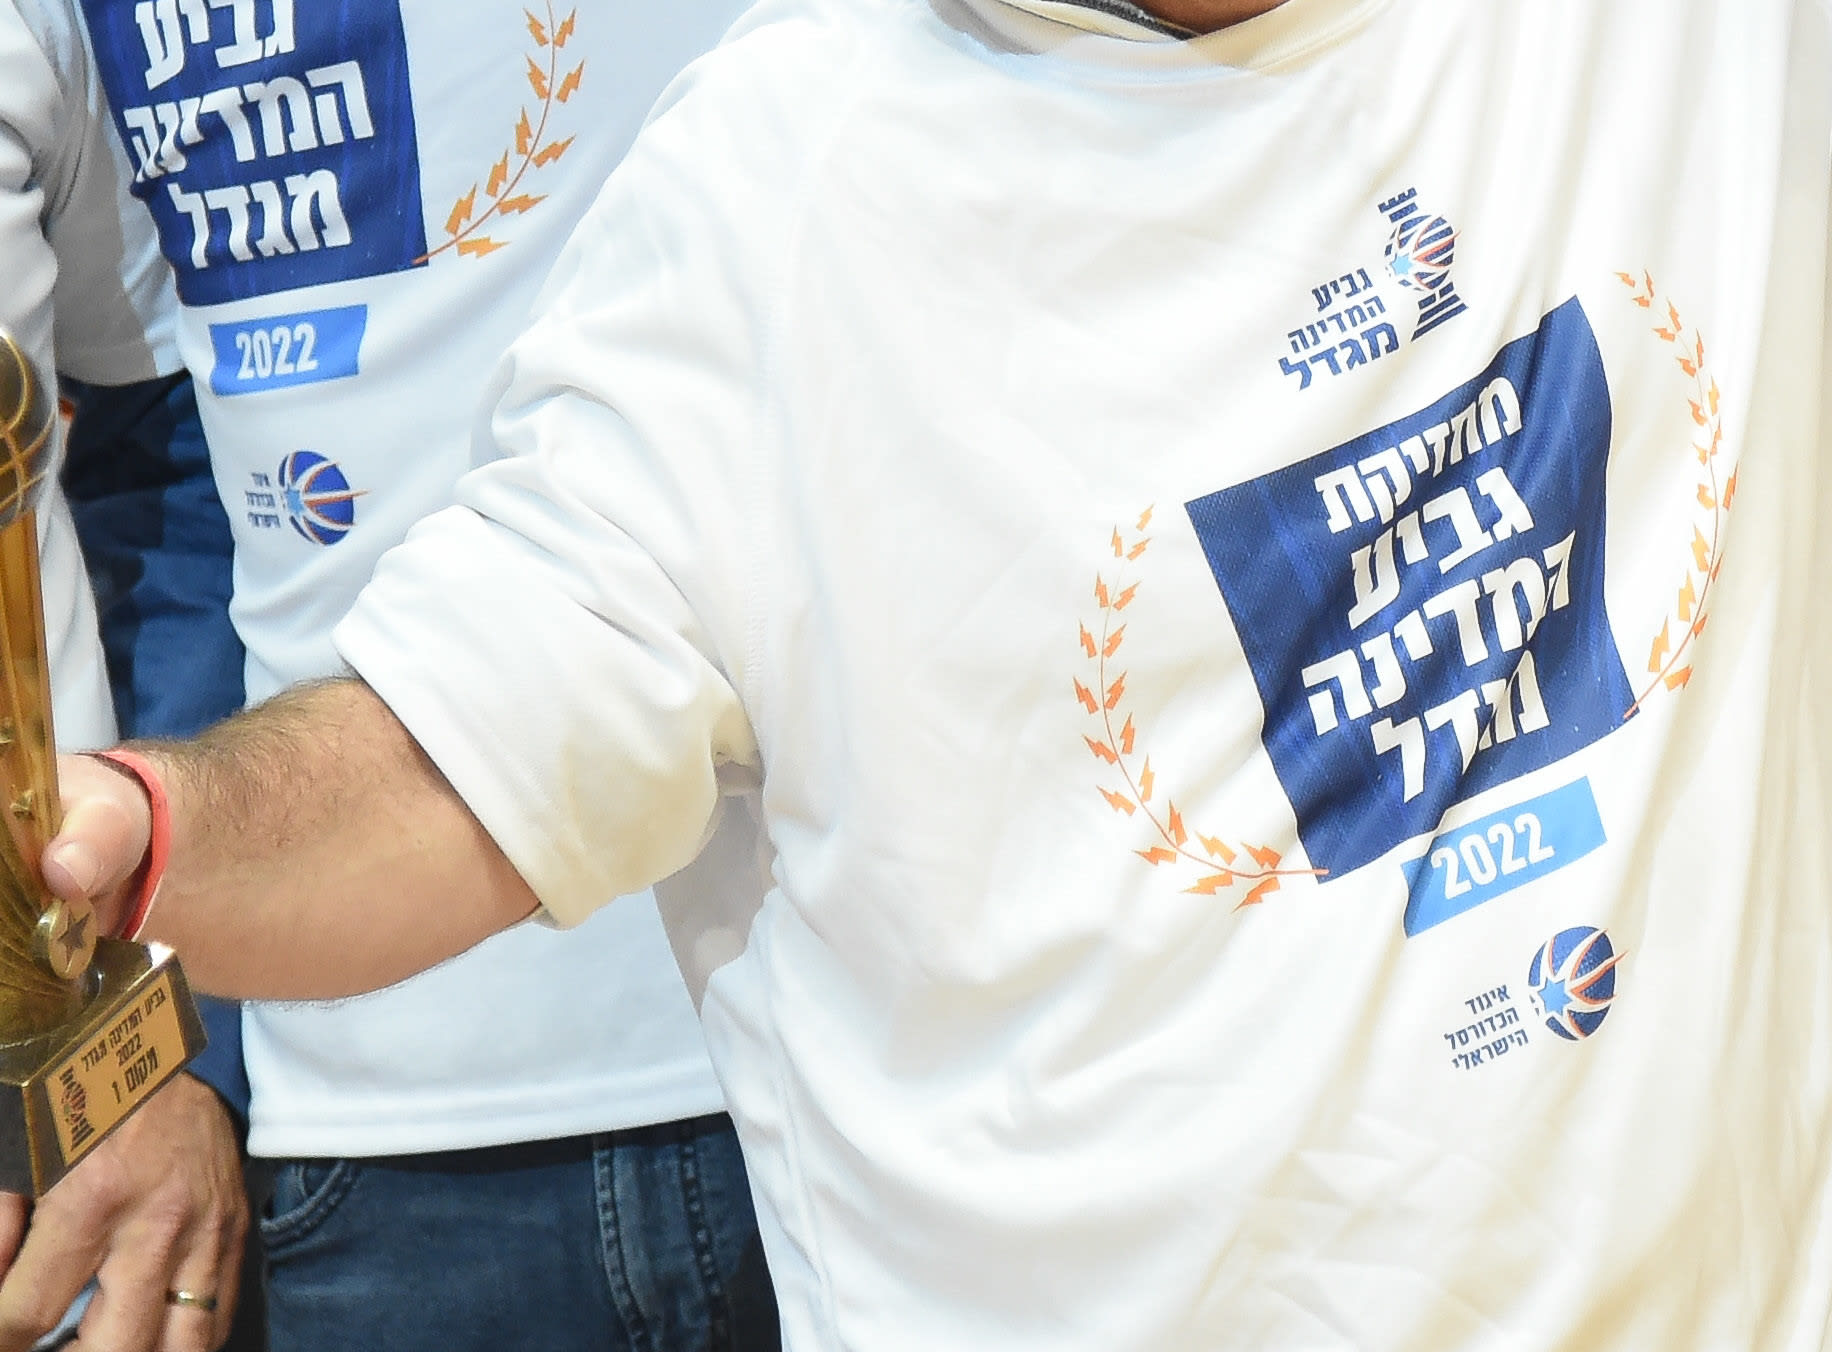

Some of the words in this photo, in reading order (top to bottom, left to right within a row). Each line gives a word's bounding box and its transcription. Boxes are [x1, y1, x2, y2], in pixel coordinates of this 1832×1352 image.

[123, 60, 375, 183] המדינה
[167, 169, 351, 268] מגדל
[1312, 267, 1373, 312] גביע
[235, 322, 319, 380] 2022
[1288, 295, 1386, 353] המדינה
[1278, 322, 1399, 391] מגדל
[1314, 377, 1522, 534] מחזיקת
[1348, 466, 1534, 630] גביע
[1370, 650, 1551, 803] מדל
[1431, 812, 1554, 900] 2022
[1465, 984, 1510, 1014] איגוד
[116, 1032, 142, 1067] 2022
[1444, 1007, 1519, 1050] הכדורסל
[1451, 1029, 1528, 1070] הישראלי
[112, 1081, 120, 1104] 1
[124, 1046, 158, 1093] מקום
